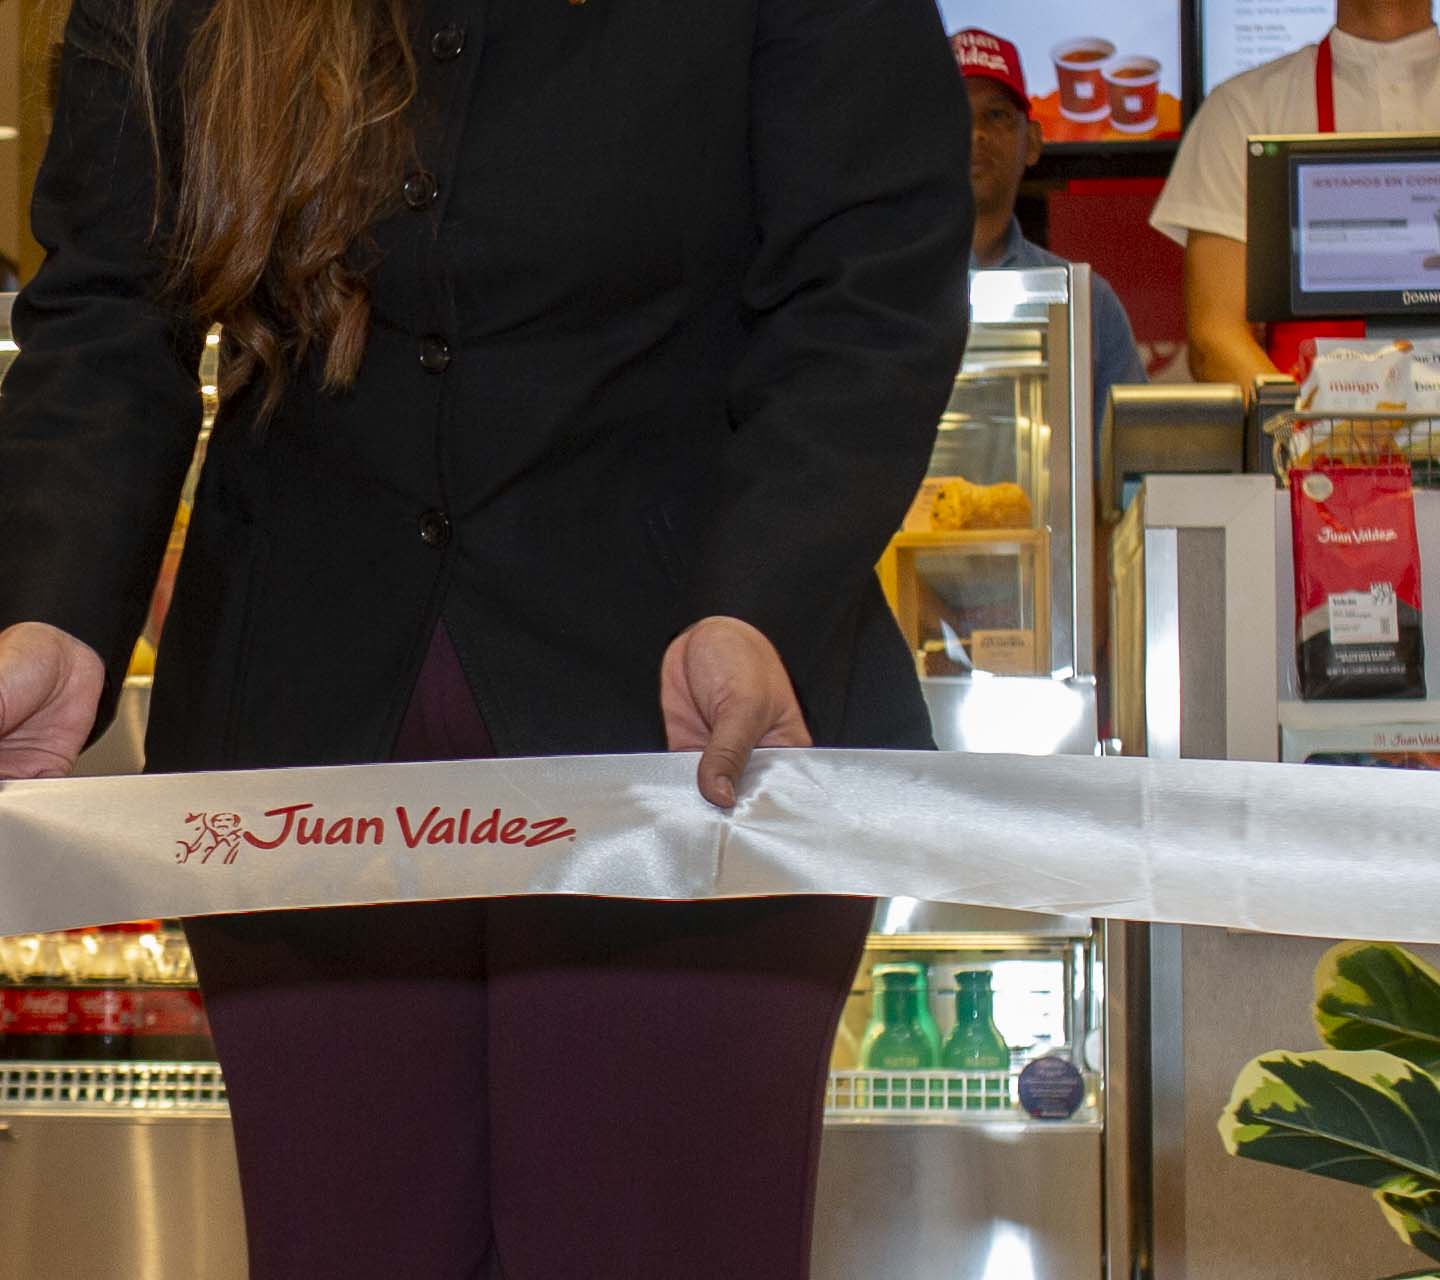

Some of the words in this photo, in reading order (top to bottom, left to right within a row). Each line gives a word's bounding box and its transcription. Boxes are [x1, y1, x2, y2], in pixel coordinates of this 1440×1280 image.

[1316, 527, 1352, 544] Juan
[1351, 528, 1399, 545] Valdez
[242, 801, 385, 850] Juan
[394, 805, 577, 849] Valdez
